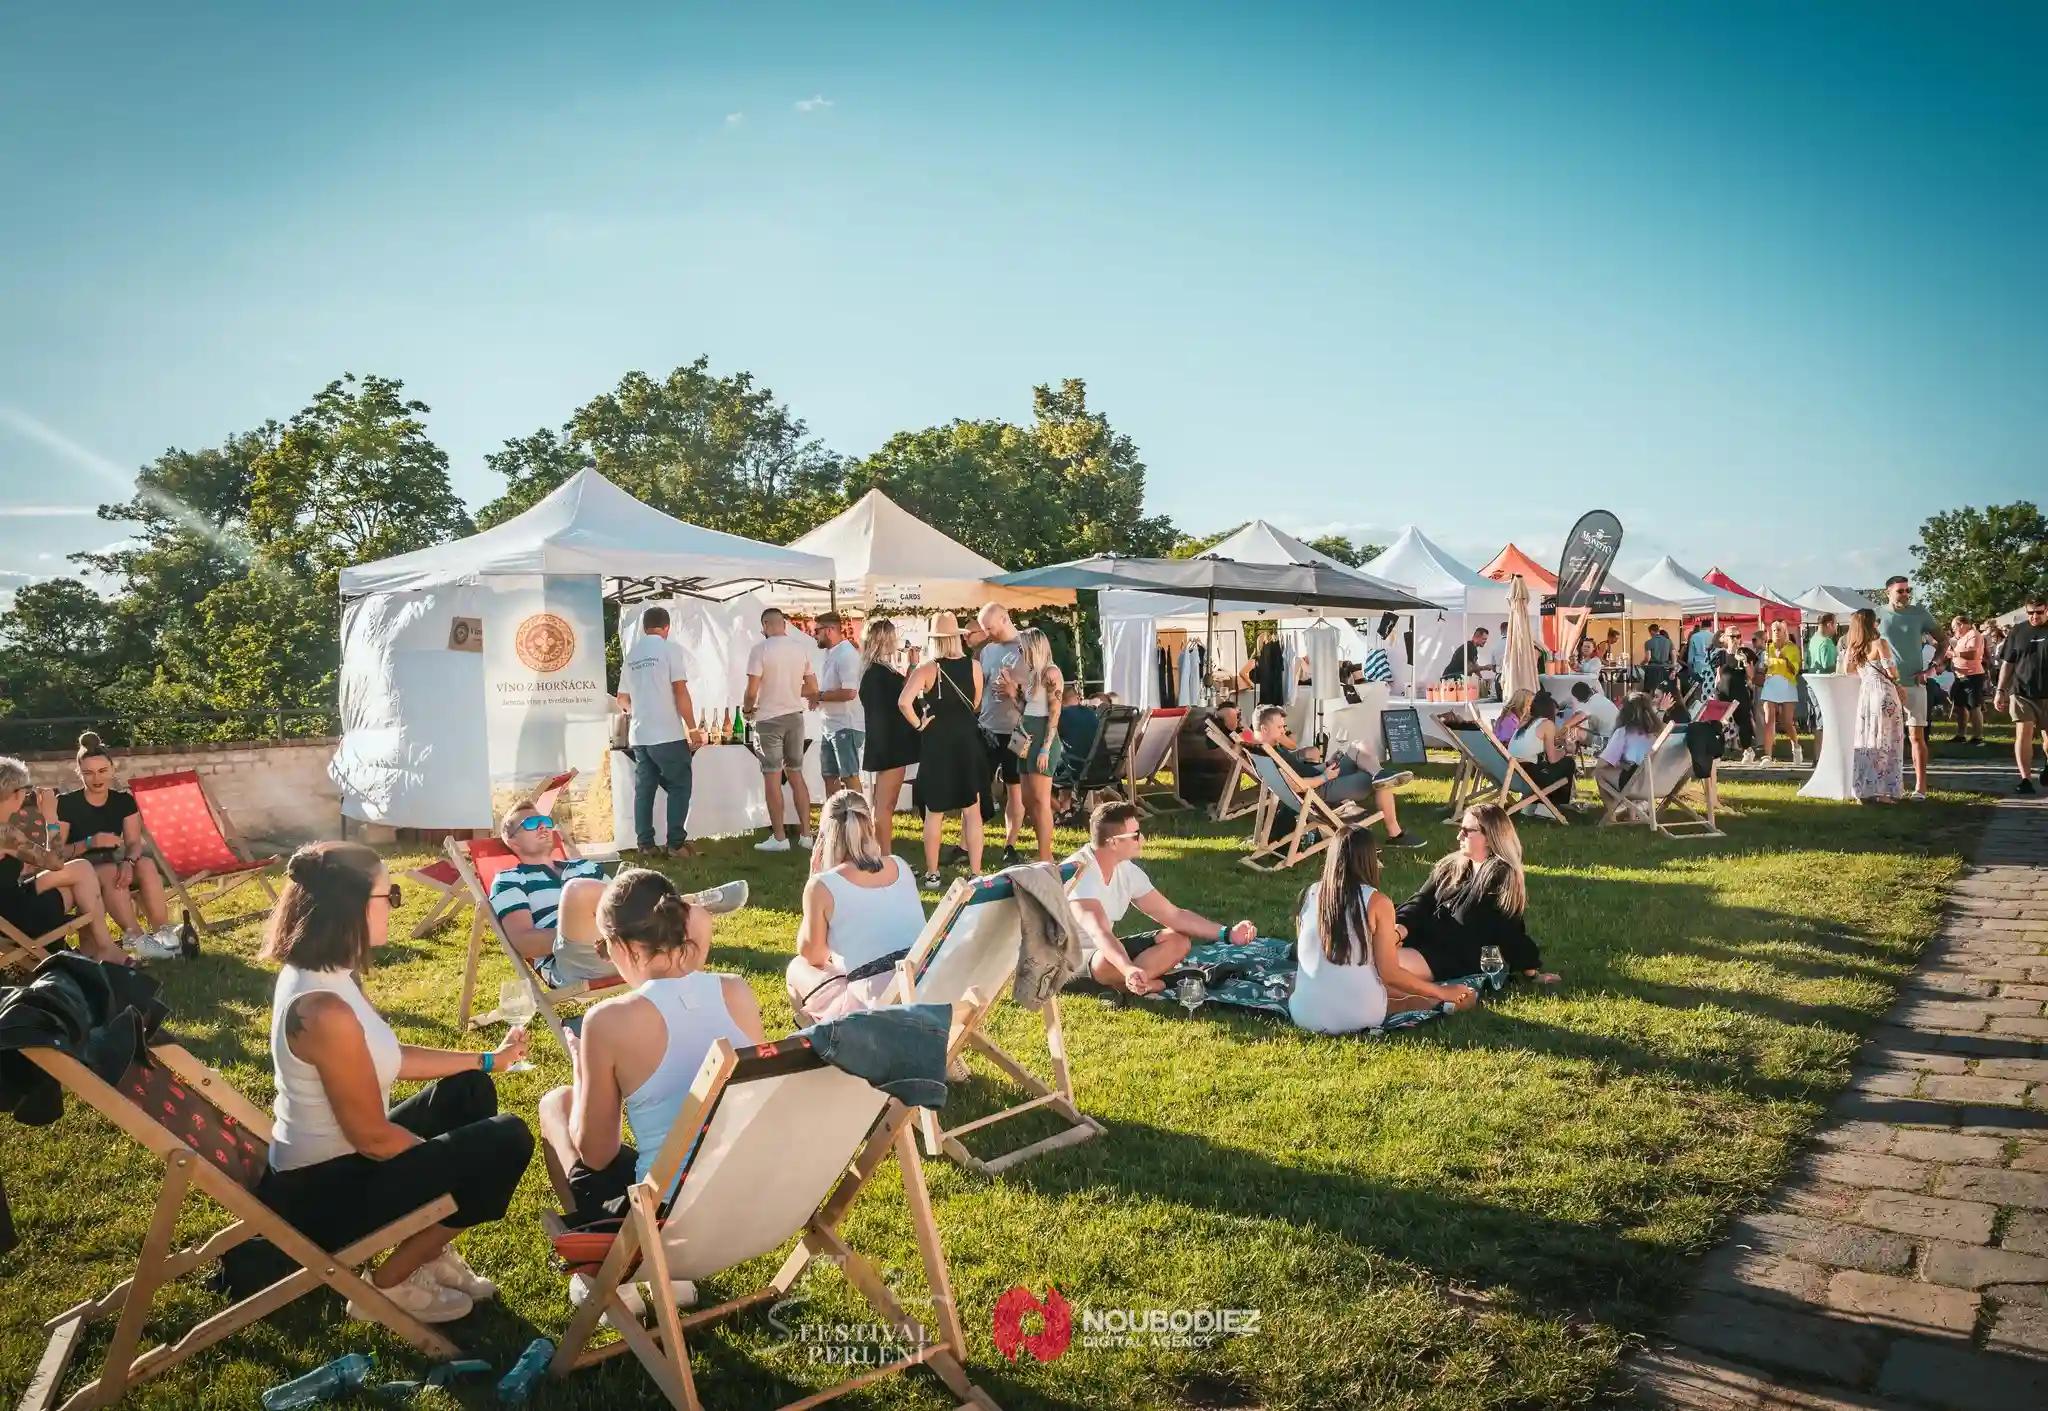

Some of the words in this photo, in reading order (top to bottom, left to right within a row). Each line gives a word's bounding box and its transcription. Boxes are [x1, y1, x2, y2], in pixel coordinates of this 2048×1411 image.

[496, 681, 525, 692] VÍNO
[527, 682, 535, 691] Z
[536, 680, 597, 691] HORŇÁCKA
